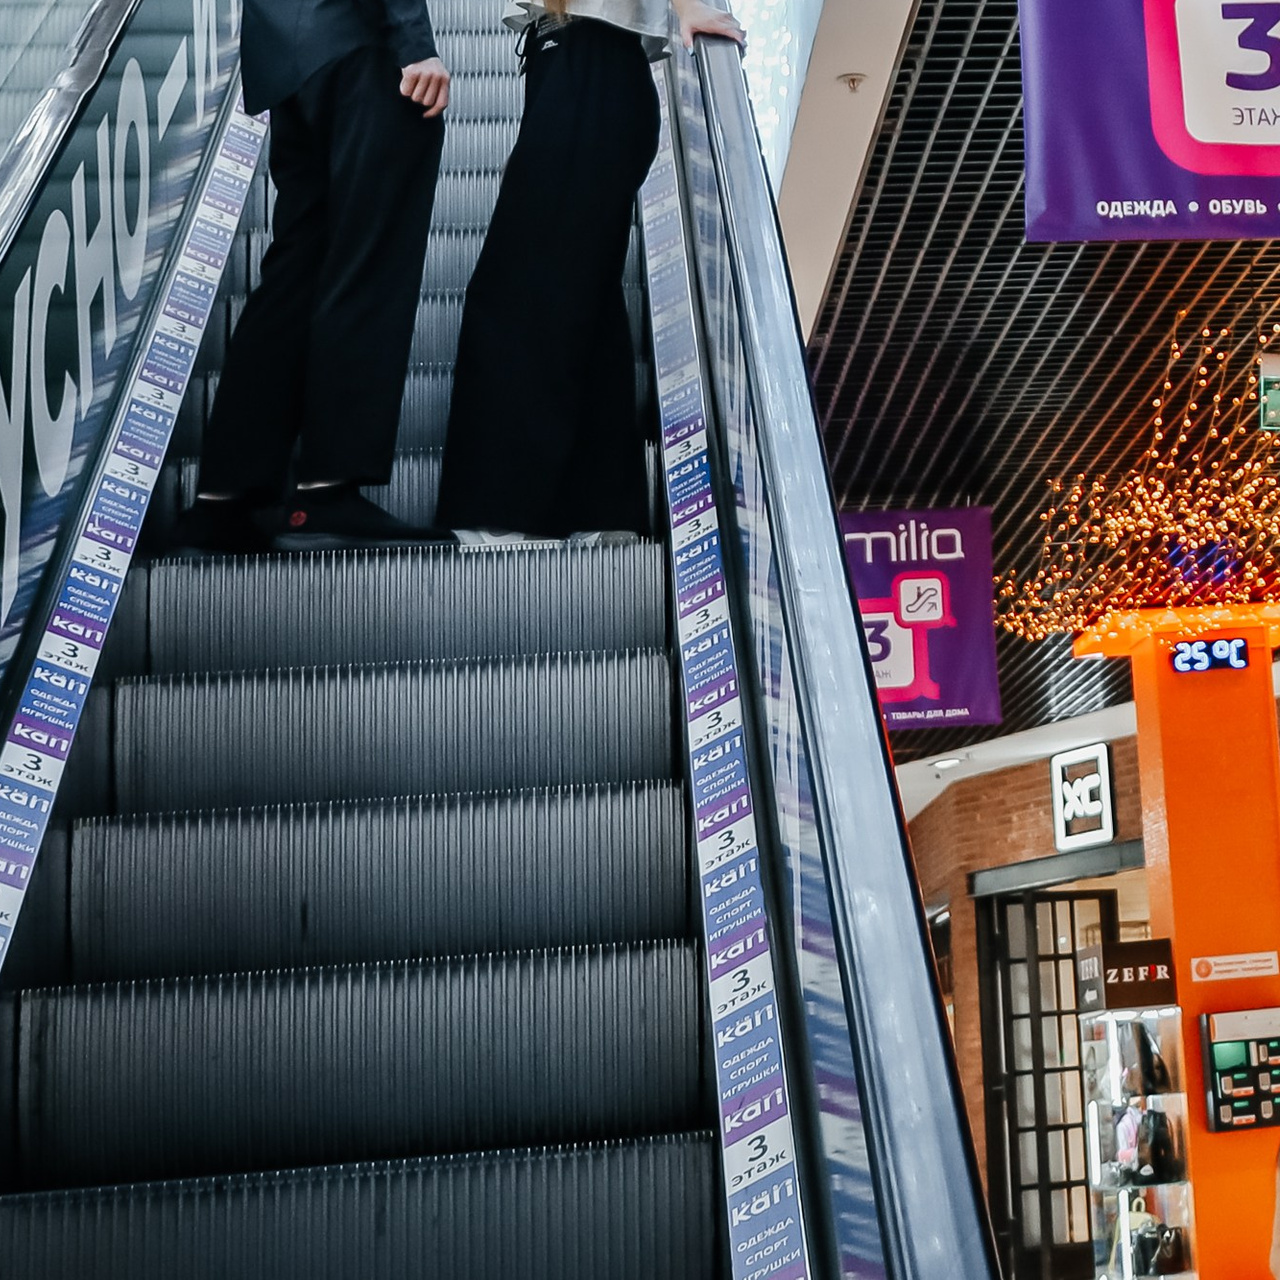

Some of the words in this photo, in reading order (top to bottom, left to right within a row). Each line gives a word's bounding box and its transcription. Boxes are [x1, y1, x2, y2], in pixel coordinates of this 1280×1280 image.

[1096, 198, 1177, 219] ОДЕЖДА
[1208, 197, 1267, 215] ОБУВЬ
[0, 56, 150, 629] УСНО
[151, 388, 165, 400] 3
[679, 440, 692, 454] 3
[125, 462, 140, 476] 3
[688, 518, 702, 533] 3
[844, 519, 965, 563] milia
[95, 546, 112, 561] 3
[69, 596, 103, 612] СПОРТ
[696, 608, 710, 625] 3
[61, 642, 79, 659] 3
[863, 619, 892, 662] 3
[874, 669, 892, 679] АЖ
[30, 688, 77, 710] ОДЕЖДА
[32, 700, 69, 717] СПОРТ
[21, 706, 74, 730] ИГРУШКИ
[707, 711, 722, 730] 3
[23, 753, 42, 771] 3
[696, 759, 740, 786] ОДЕЖДА
[3, 764, 53, 787] этаж
[702, 771, 736, 794] СПОРТ
[697, 778, 745, 809] ИГРУШКИ
[0, 811, 39, 831] ДЕЖДА
[0, 824, 30, 839] ПОРТ
[0, 836, 35, 854] УШКИ
[718, 829, 735, 850] 3
[705, 838, 751, 869] этаж
[709, 885, 757, 916] ОДЕЖДА
[715, 899, 752, 924] СПОРТ
[709, 907, 762, 942] ИГРУШКИ
[732, 968, 750, 993] 3
[717, 980, 767, 1015] этаж
[722, 1036, 774, 1069] ОДЕЖДА
[730, 1052, 769, 1080] СПОРТ
[722, 1062, 780, 1100] ИГРУШКИ
[747, 1134, 769, 1162] 3
[731, 1149, 787, 1188] этаж
[737, 1216, 794, 1253] ОДЕЖДА
[745, 1235, 789, 1266] СПОРТ
